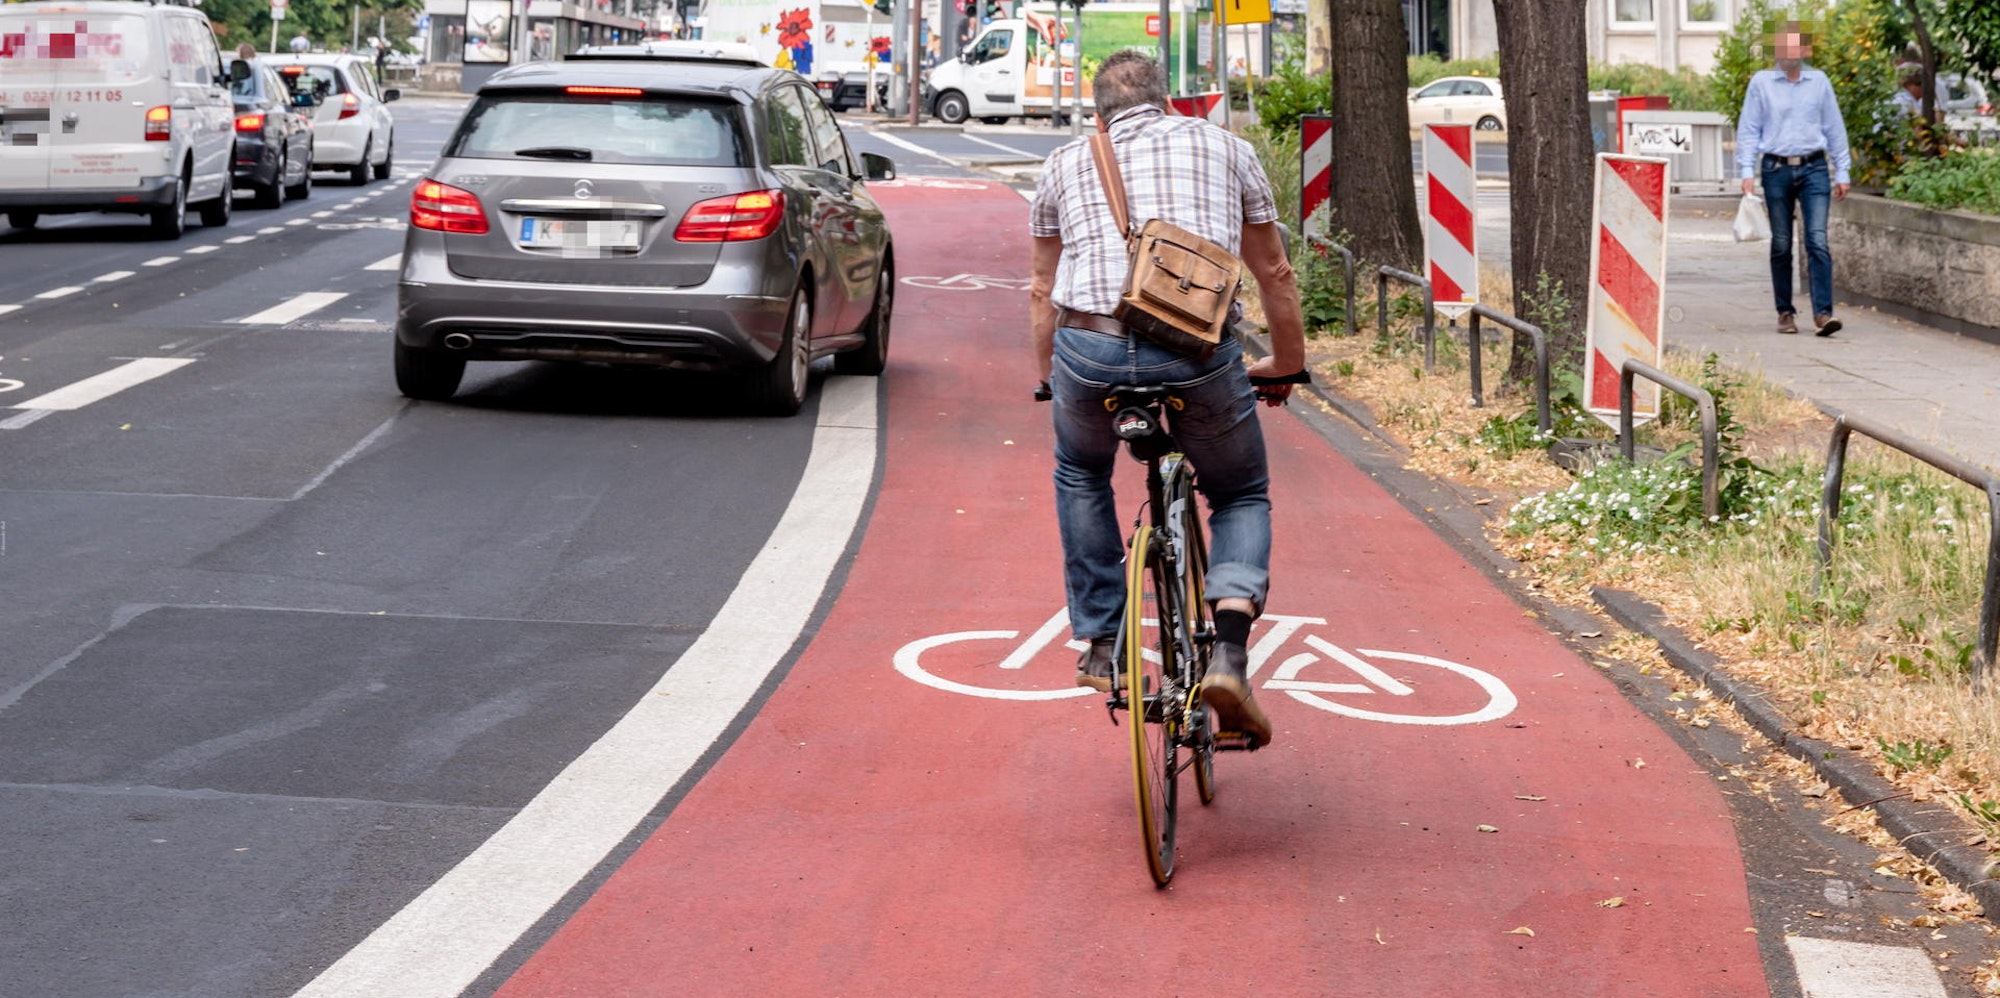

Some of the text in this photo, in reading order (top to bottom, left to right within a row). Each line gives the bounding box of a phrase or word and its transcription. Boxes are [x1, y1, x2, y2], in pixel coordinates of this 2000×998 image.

[66, 90, 82, 103] 12
[86, 90, 101, 103] 11
[105, 90, 123, 102] 05
